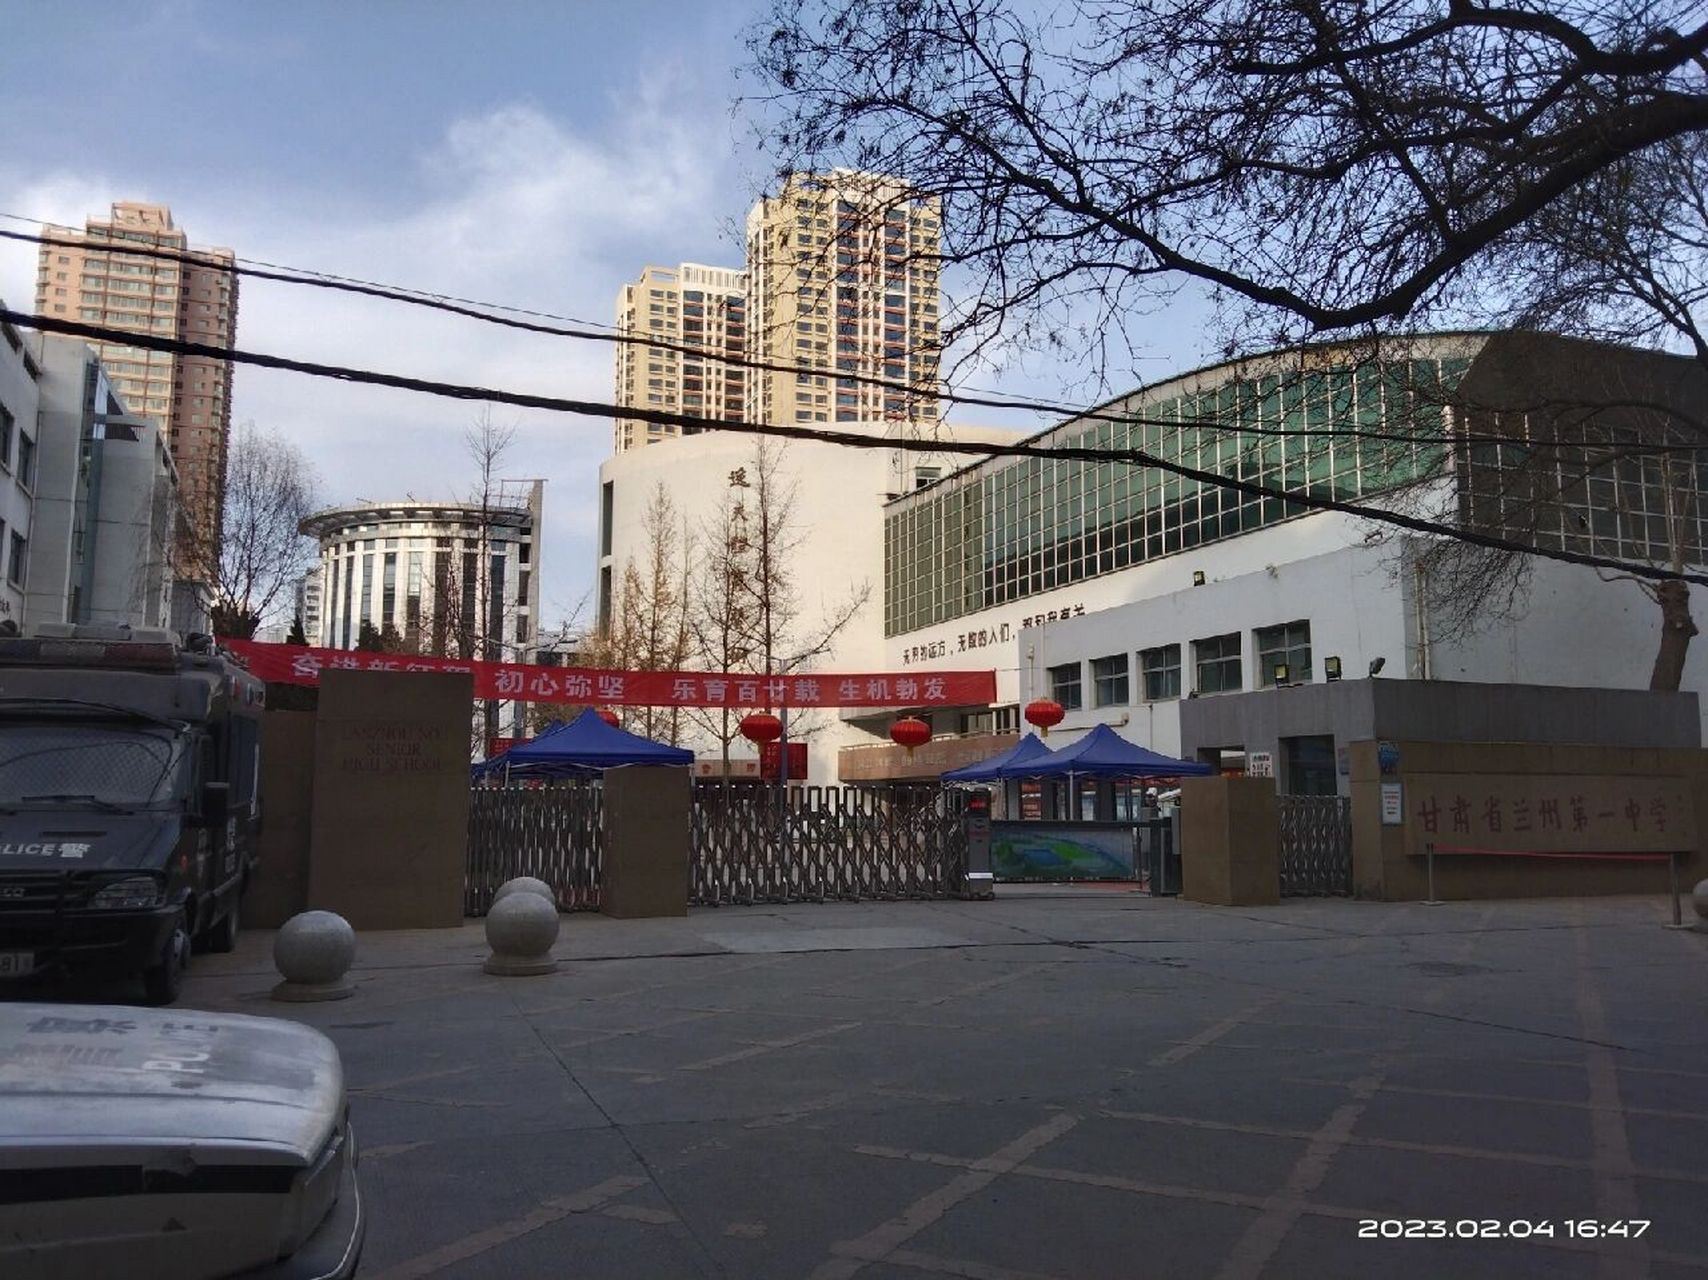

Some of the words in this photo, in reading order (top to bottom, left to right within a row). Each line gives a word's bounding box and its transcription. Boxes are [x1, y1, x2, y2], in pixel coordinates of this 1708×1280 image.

[495, 669, 625, 699] 初心弥坚
[672, 678, 820, 702] 乐育百廿载
[838, 677, 947, 701] 生机勃发
[367, 742, 422, 755] SENIOR
[342, 756, 380, 769] HIGH
[386, 756, 441, 769] SCHOOL
[1417, 795, 1667, 833] 甘肃省兰州第一中学
[0, 843, 56, 855] LICE
